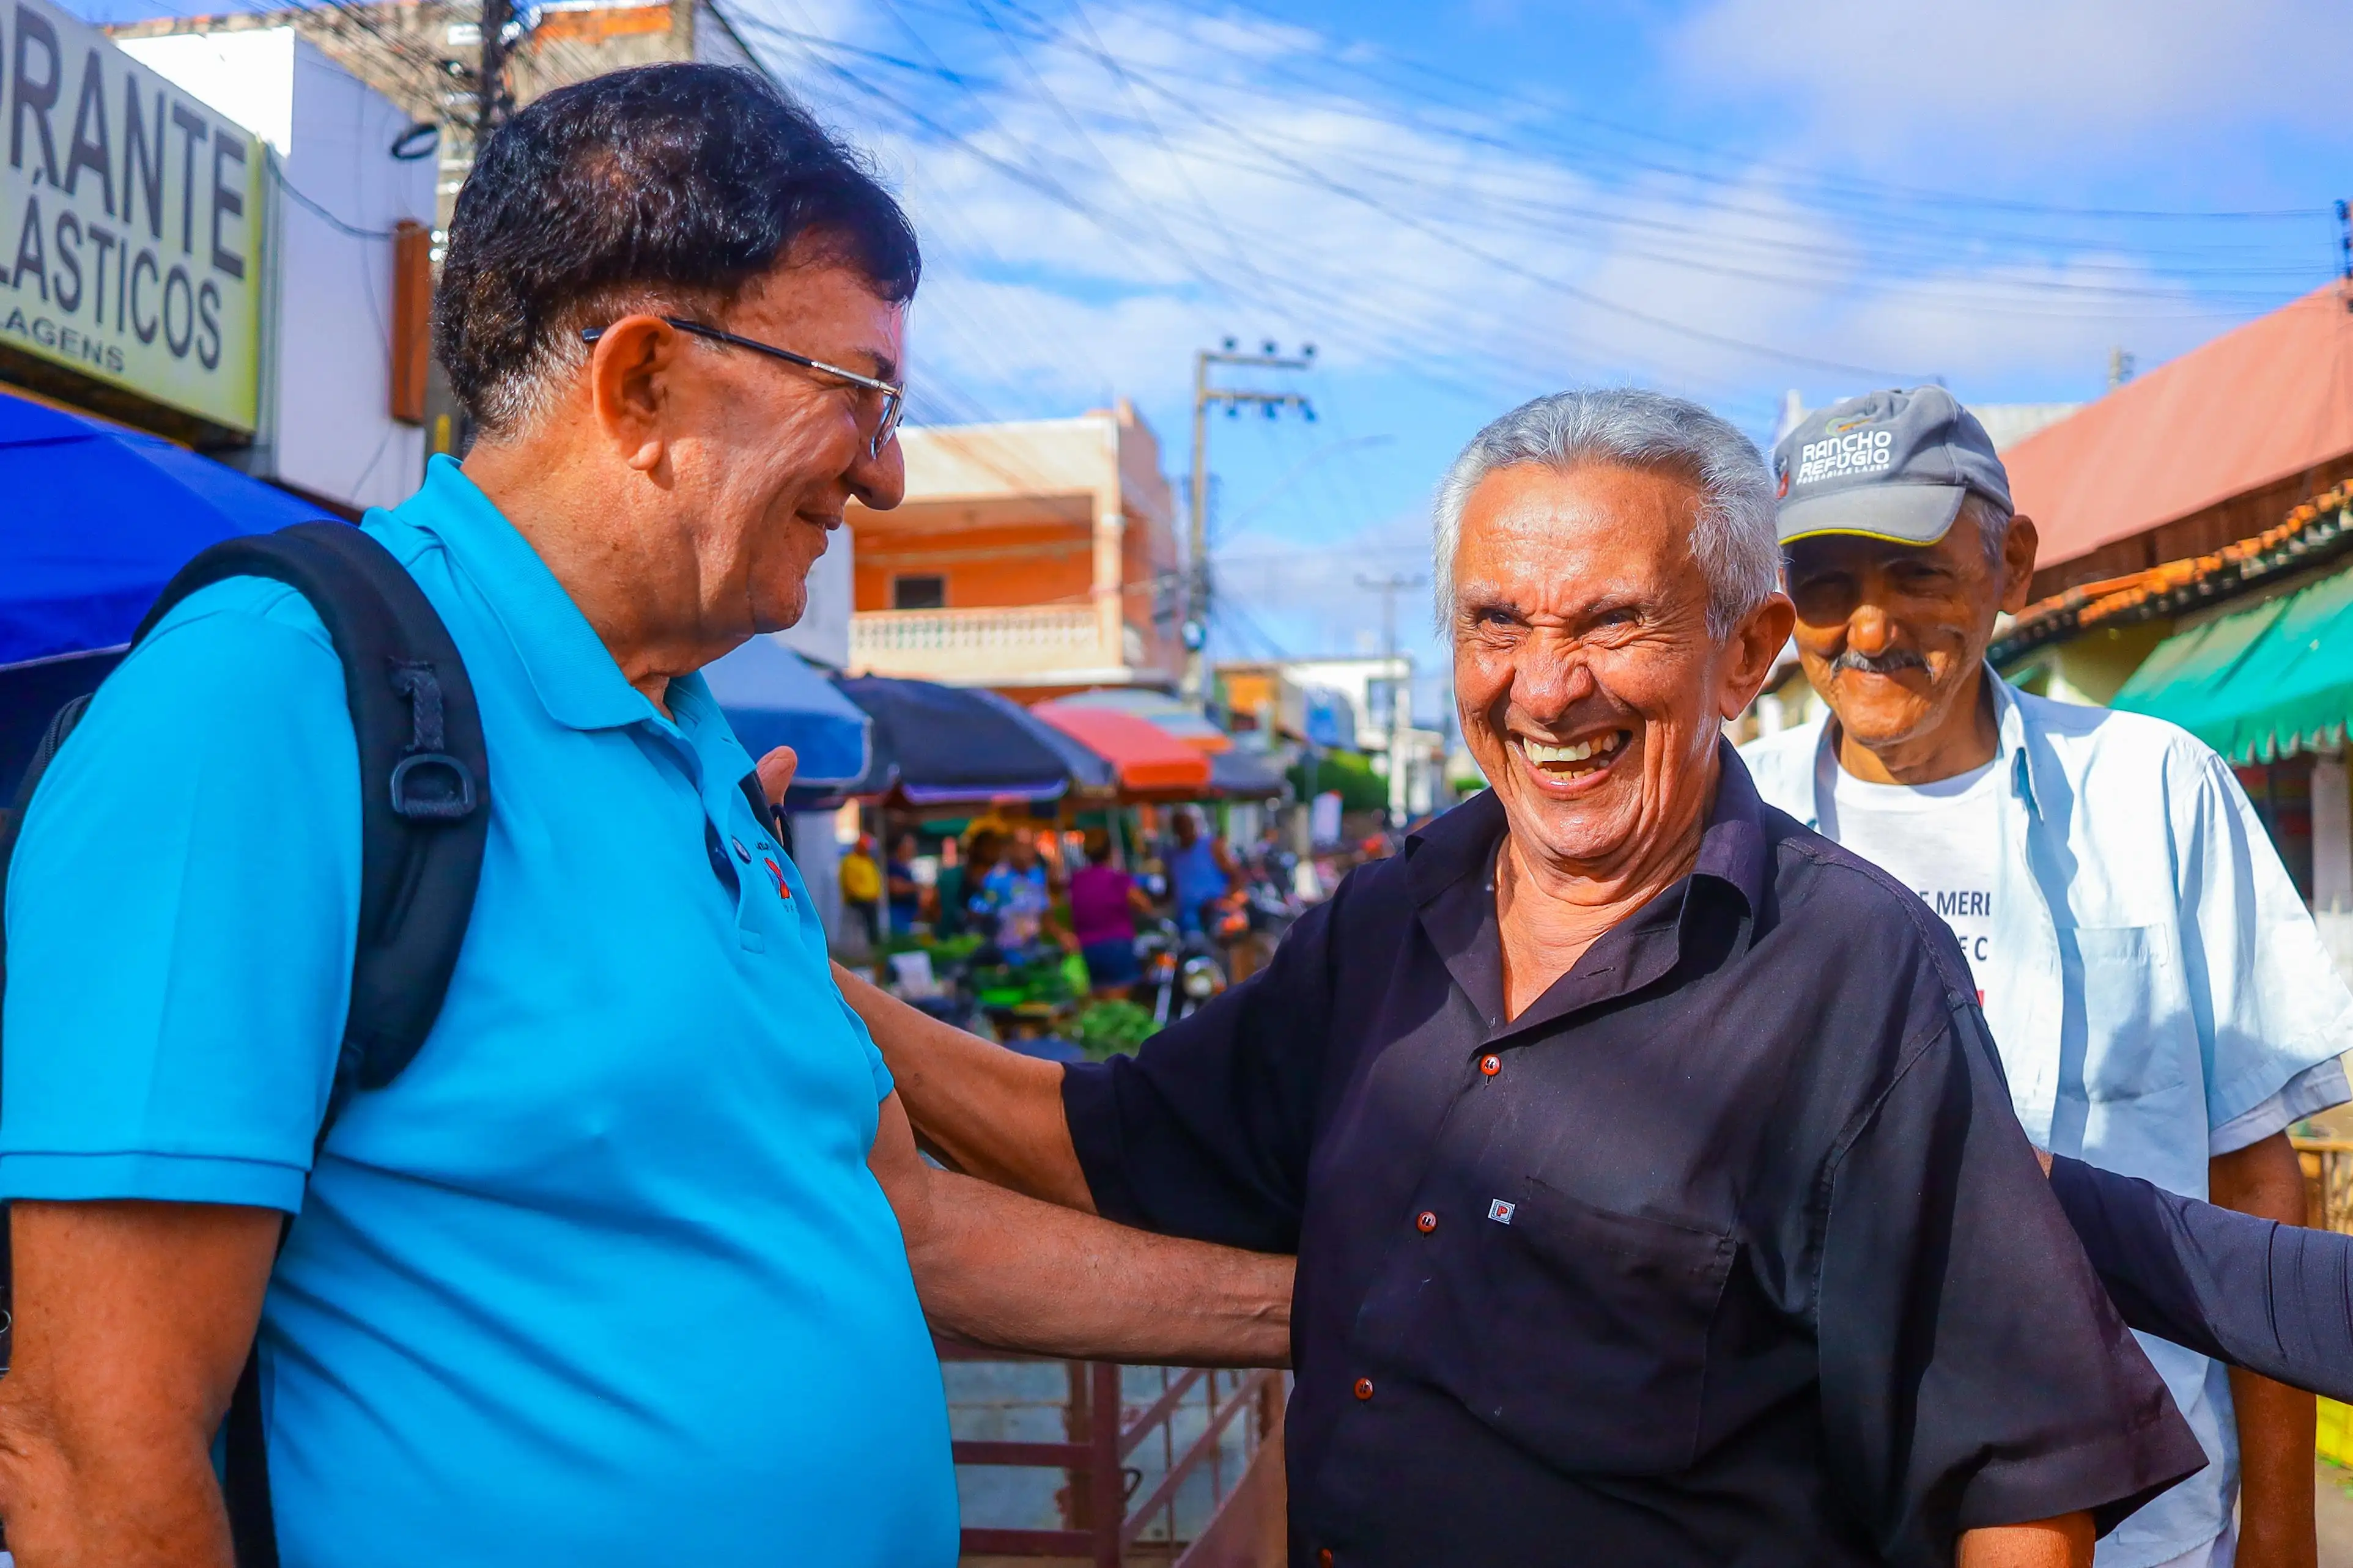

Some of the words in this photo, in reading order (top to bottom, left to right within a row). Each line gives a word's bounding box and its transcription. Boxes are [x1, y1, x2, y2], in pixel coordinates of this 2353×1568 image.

[0, 2, 246, 280] RANTE
[0, 306, 125, 372] AGENS
[1803, 430, 1892, 462] RANCHO
